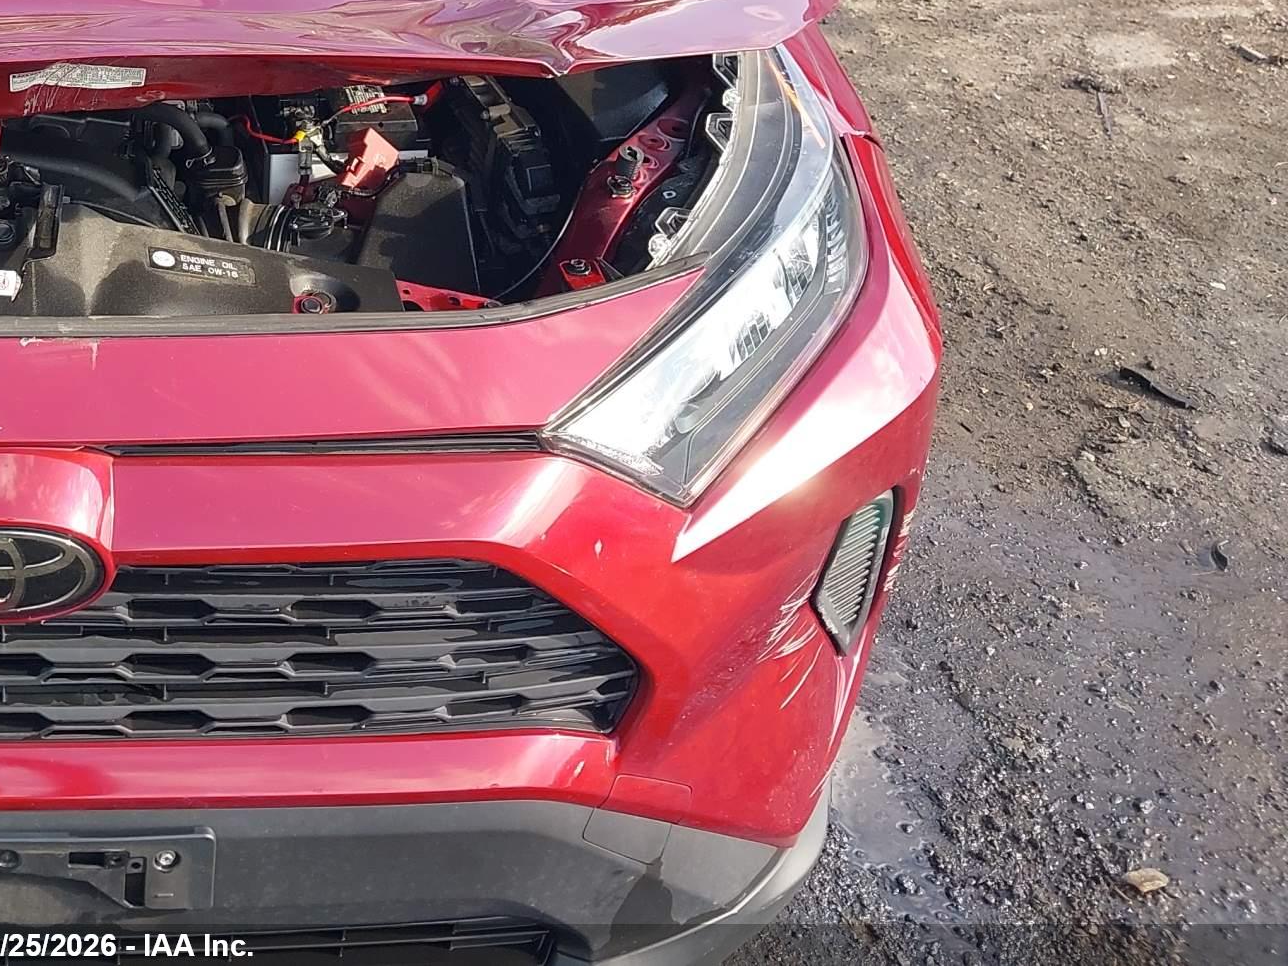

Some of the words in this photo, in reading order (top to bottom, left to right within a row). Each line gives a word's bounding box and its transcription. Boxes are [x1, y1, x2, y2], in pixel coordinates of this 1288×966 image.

[180, 254, 216, 267] ENGINE
[221, 261, 238, 271] OIL
[182, 262, 202, 273] SAE
